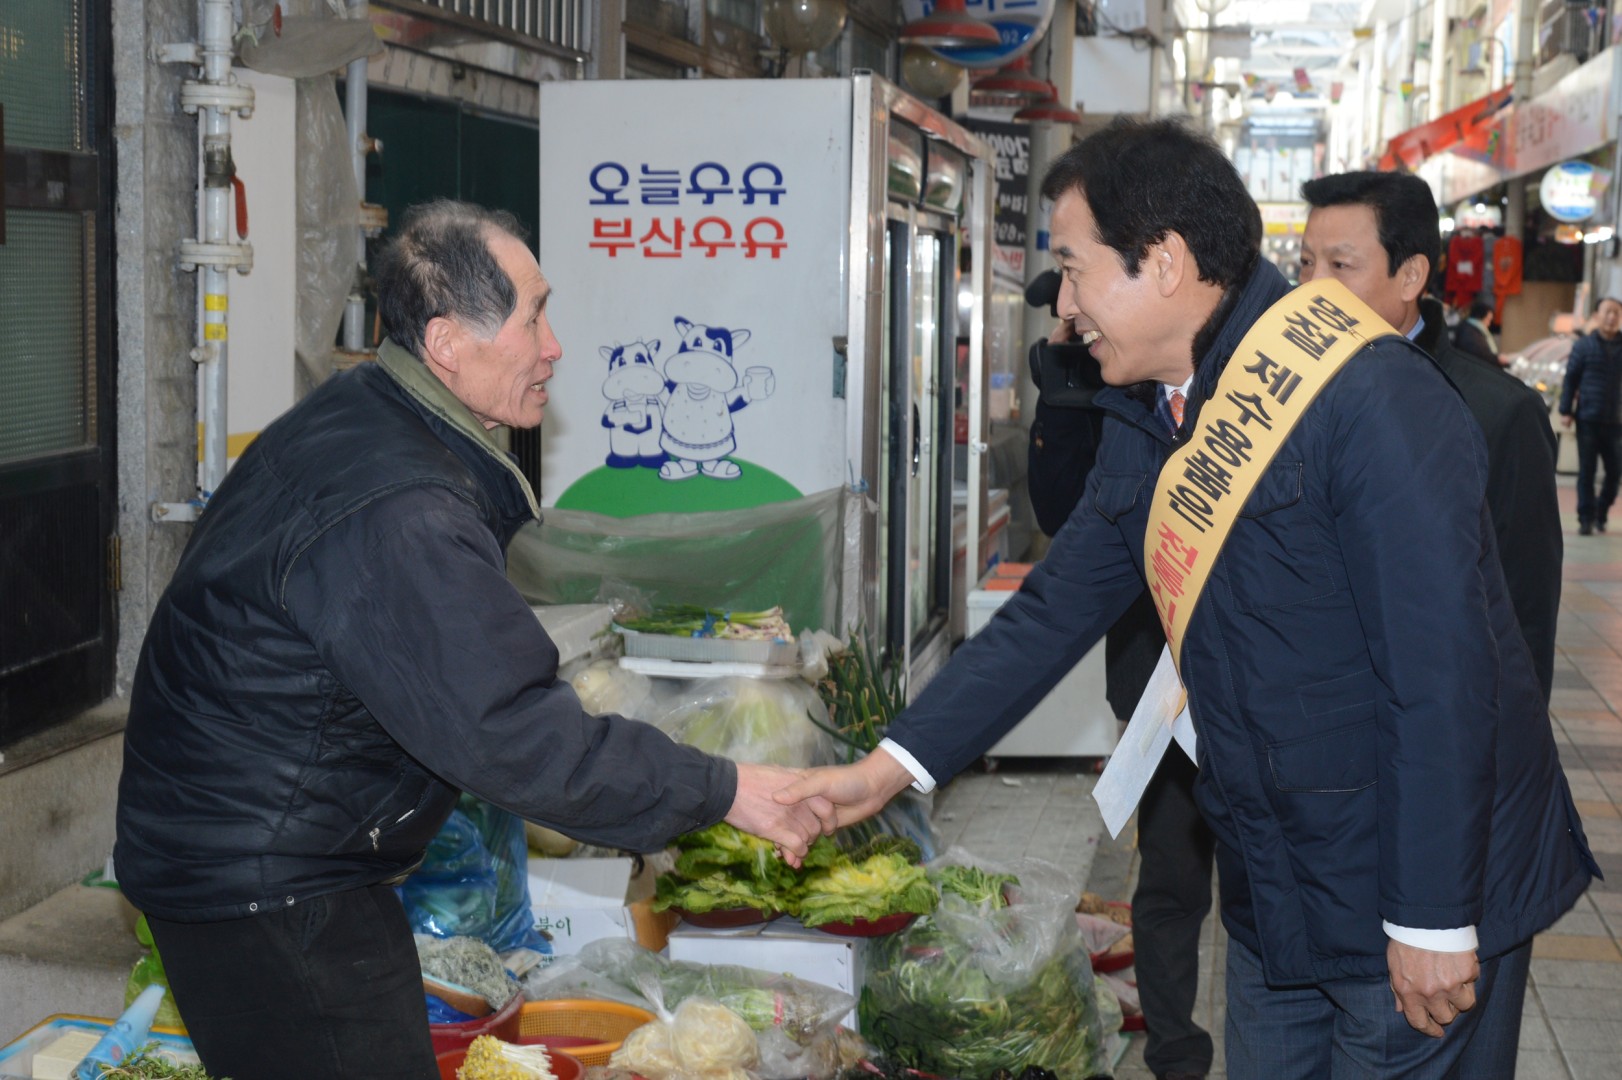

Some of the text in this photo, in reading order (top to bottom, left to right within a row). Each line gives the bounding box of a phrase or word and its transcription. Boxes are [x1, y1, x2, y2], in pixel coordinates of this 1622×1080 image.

[588, 216, 788, 259] 부산우유
[1280, 293, 1361, 362] 명절
[1151, 520, 1200, 646] 전통시
